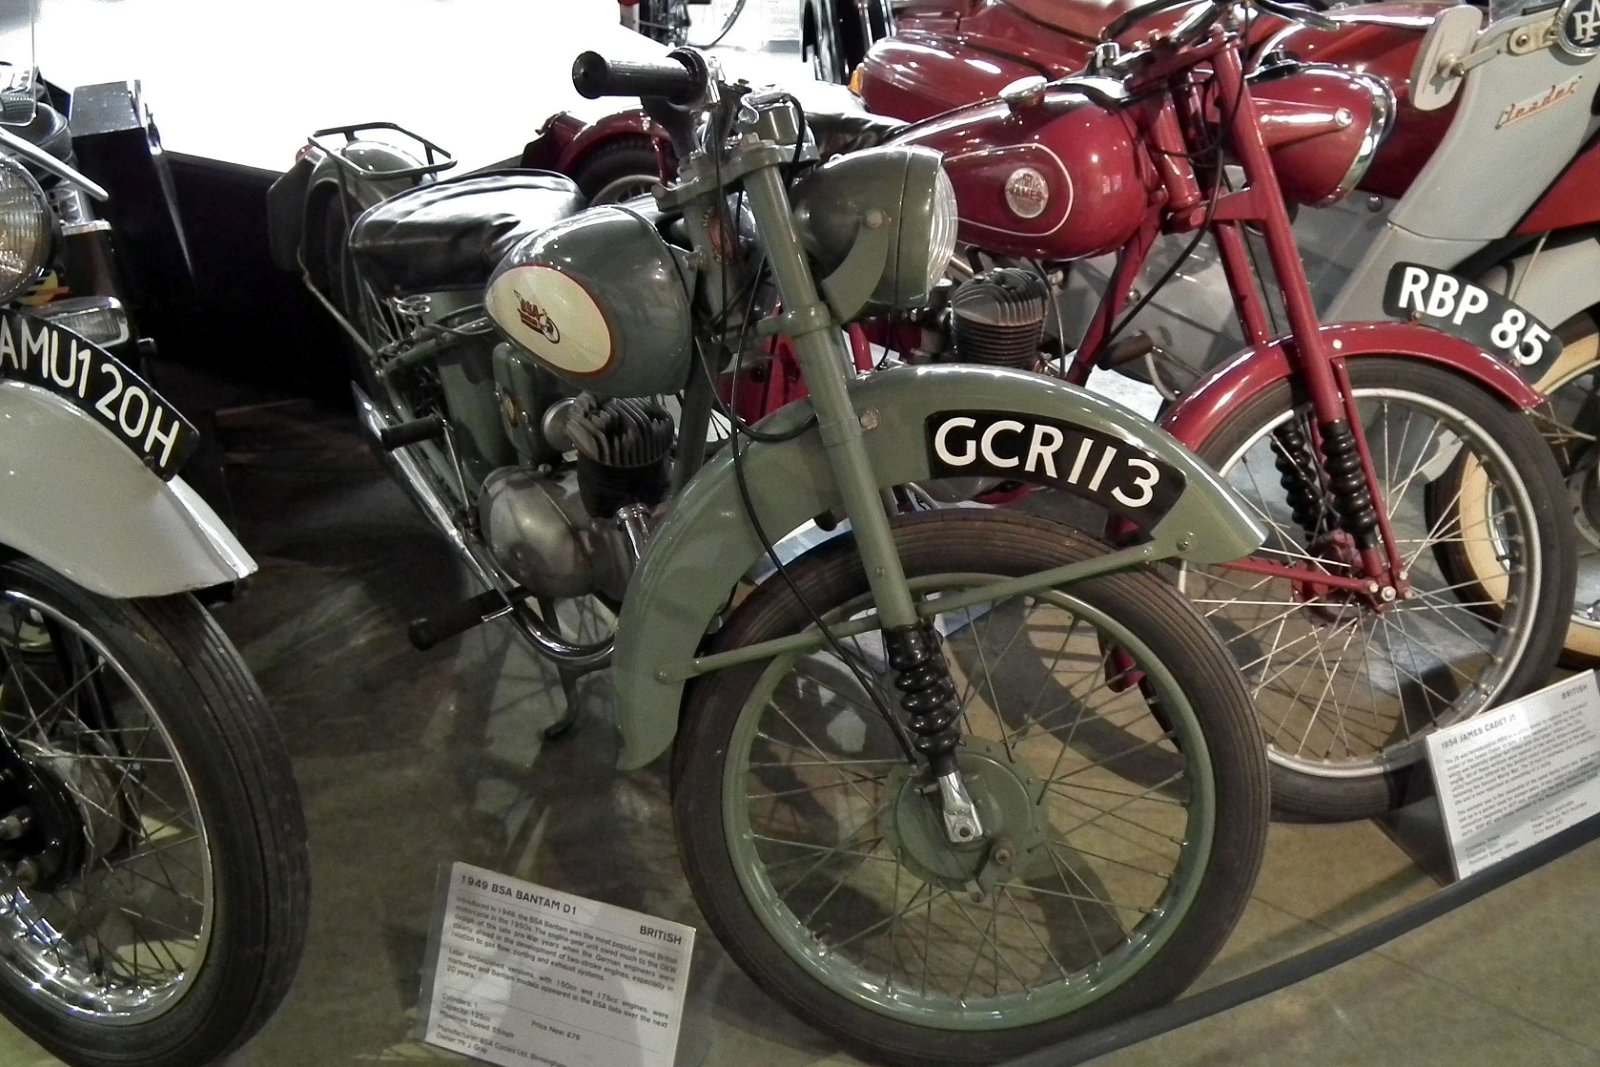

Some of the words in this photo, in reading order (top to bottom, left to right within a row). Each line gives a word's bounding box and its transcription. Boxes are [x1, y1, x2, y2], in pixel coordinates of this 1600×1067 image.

[1398, 266, 1489, 326] RBP
[1491, 308, 1552, 366] 85
[1458, 726, 1483, 742] JAMES
[1483, 716, 1507, 732] CADET
[461, 875, 488, 890] 1949
[491, 883, 512, 896] BSA
[515, 890, 560, 910] BANTAM
[562, 903, 576, 915] D1
[529, 916, 542, 925] BSA
[544, 921, 567, 933] Bantam
[569, 928, 581, 937] was
[594, 935, 611, 945] most
[611, 940, 636, 952] popular
[586, 942, 598, 951] unit
[599, 946, 618, 956] owed
[619, 951, 637, 962] much
[639, 925, 682, 944] BRITISH
[515, 940, 556, 957] development
[566, 955, 601, 971] two-stroke
[632, 974, 665, 989] especially
[541, 938, 559, 949] years
[562, 944, 579, 954] when
[595, 953, 620, 966] German
[623, 962, 655, 976] engineers
[658, 971, 675, 982] were
[592, 999, 605, 1009] BSA
[623, 1009, 637, 1019] over
[652, 1018, 667, 1028] next
